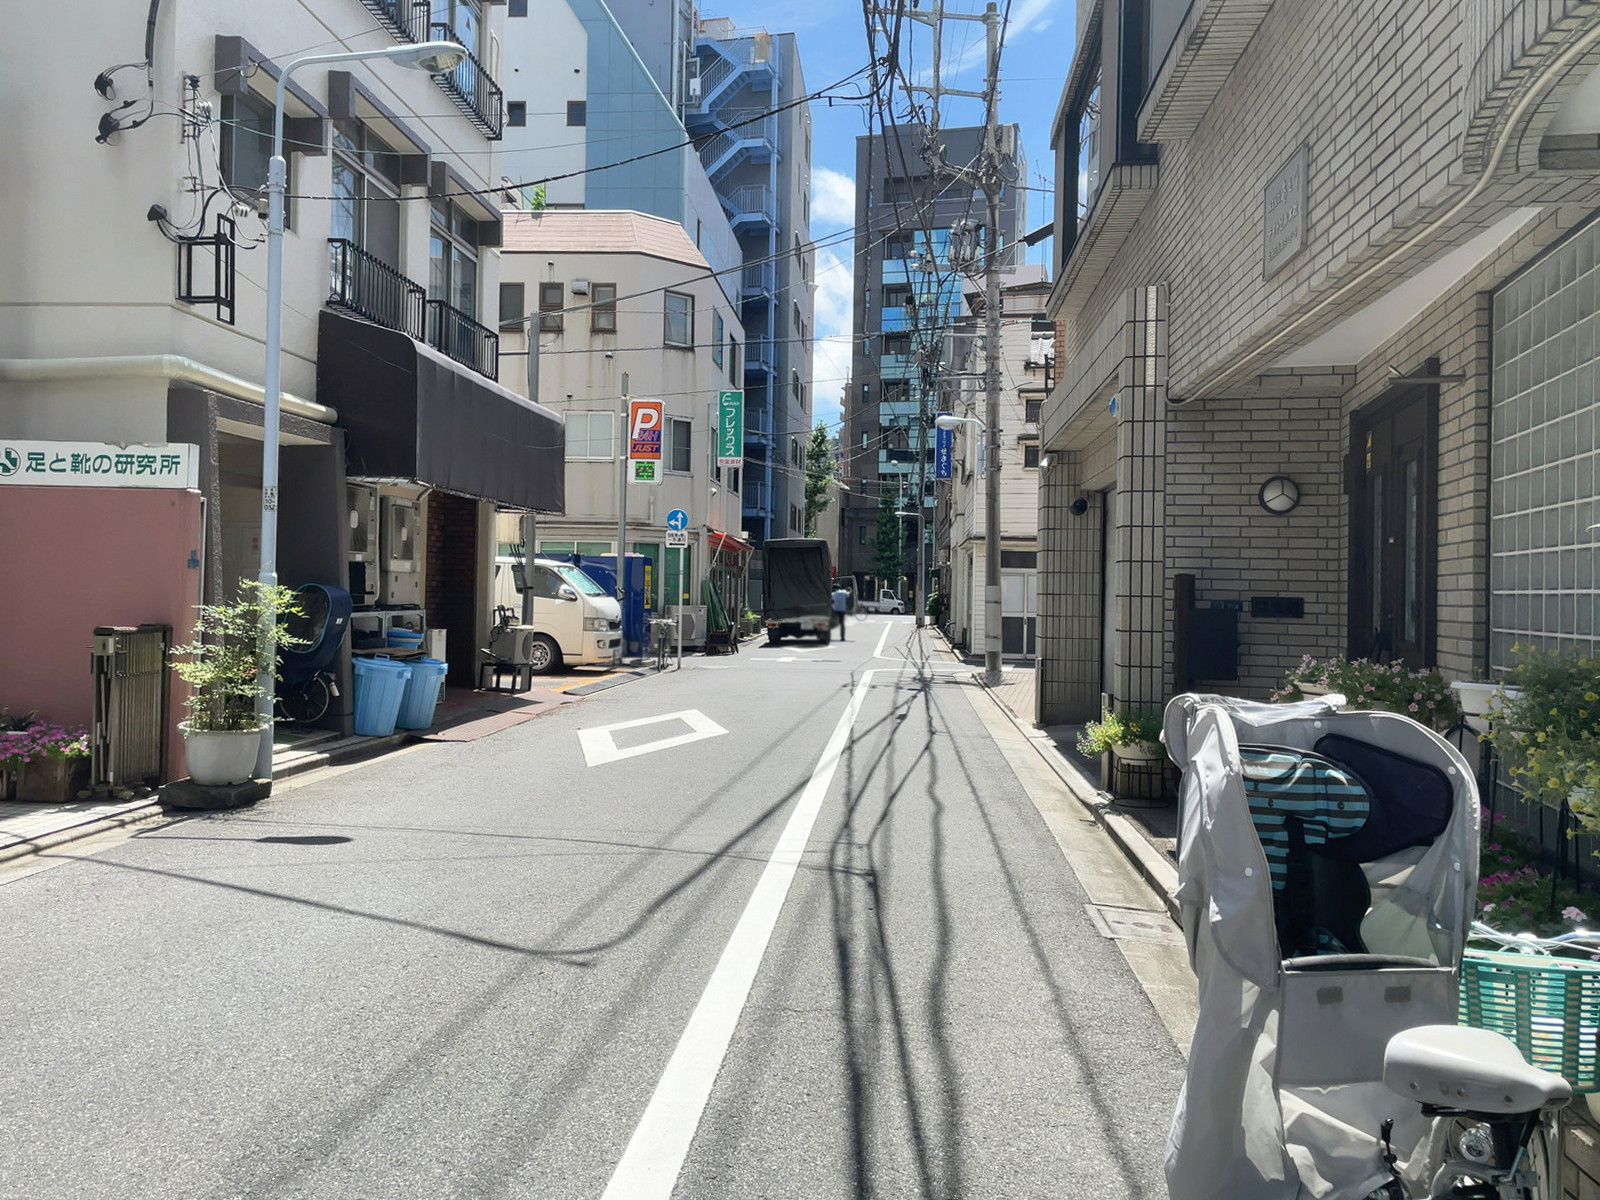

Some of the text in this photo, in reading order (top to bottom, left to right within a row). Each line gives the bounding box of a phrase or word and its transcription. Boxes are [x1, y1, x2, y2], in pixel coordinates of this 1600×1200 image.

[632, 408, 659, 439] P
[725, 408, 736, 456] フレックス
[632, 444, 659, 453] JUST
[25, 452, 181, 475] 足と靴の研究所
